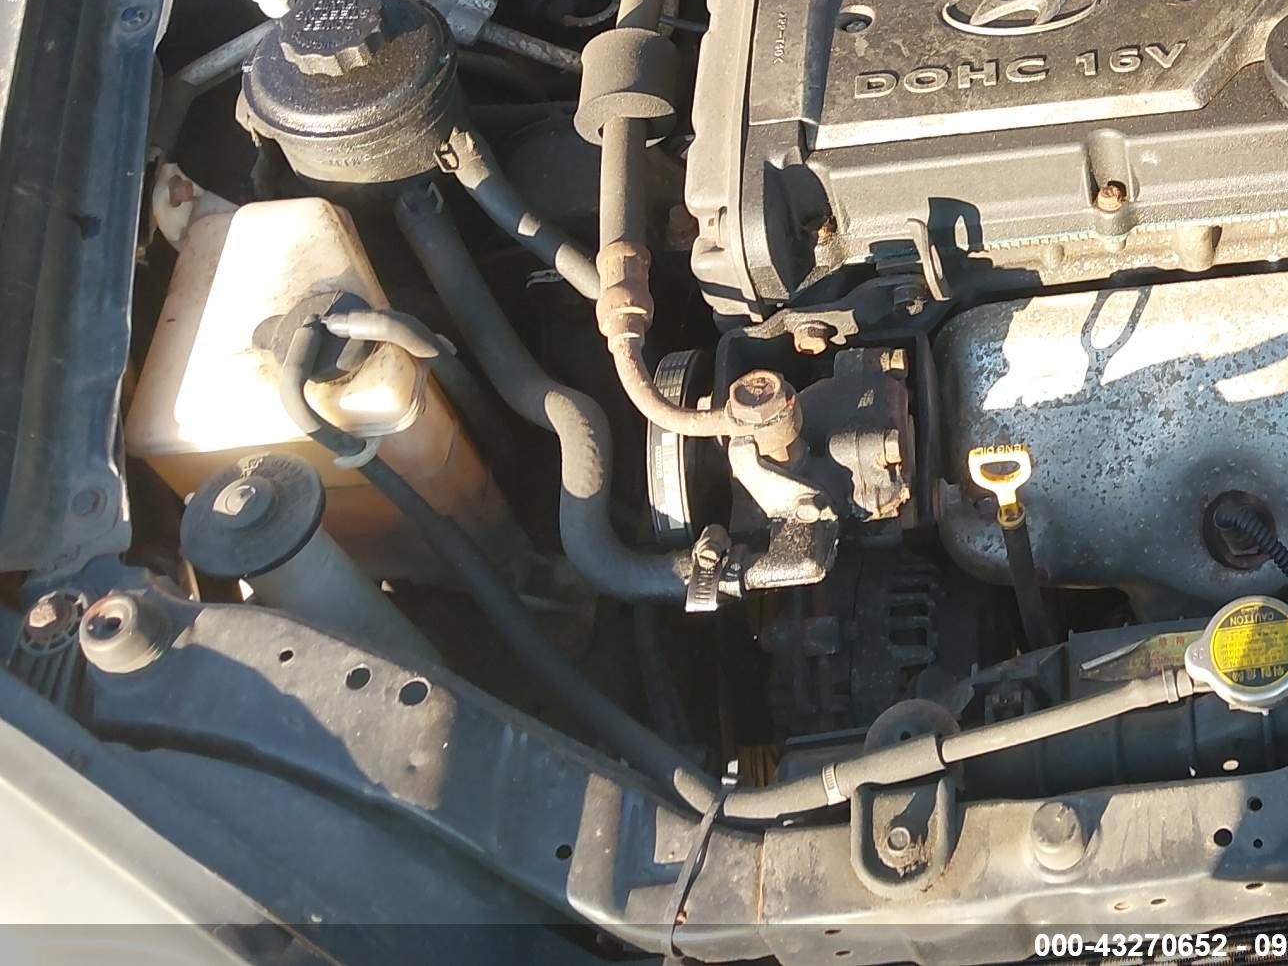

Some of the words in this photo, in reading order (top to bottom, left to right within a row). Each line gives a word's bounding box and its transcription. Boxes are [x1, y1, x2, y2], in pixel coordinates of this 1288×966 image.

[855, 57, 1048, 99] DOHC
[1075, 40, 1189, 78] 16V
[1229, 610, 1275, 627] CAUTION
